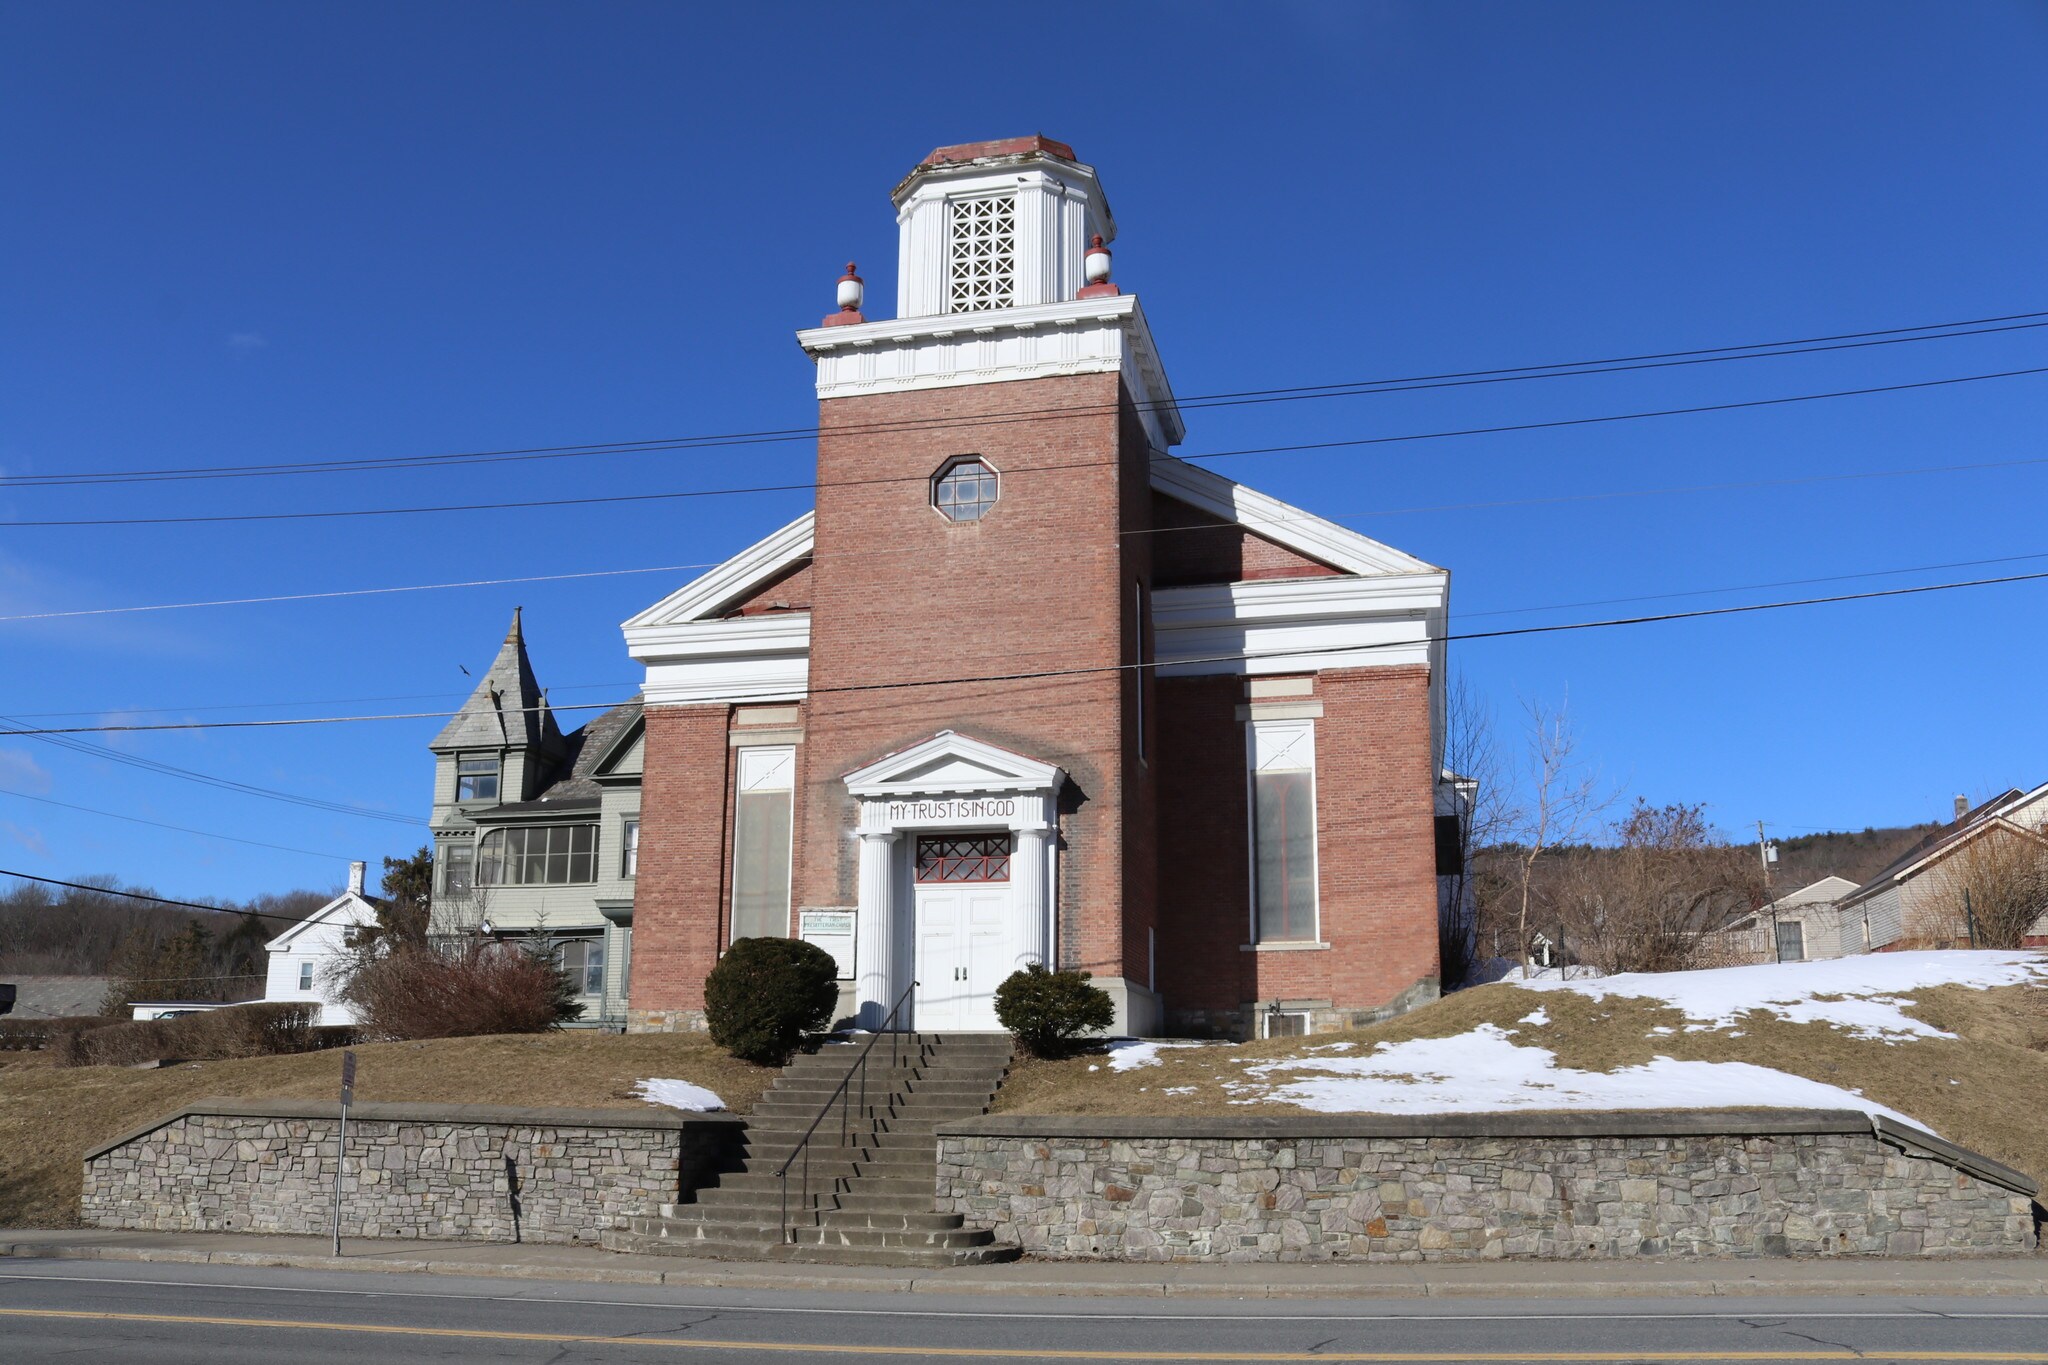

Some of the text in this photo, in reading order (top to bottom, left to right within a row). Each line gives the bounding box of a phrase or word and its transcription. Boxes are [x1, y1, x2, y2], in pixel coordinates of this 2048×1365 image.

[890, 800, 1015, 820] MY TRUST IS IN GOD
